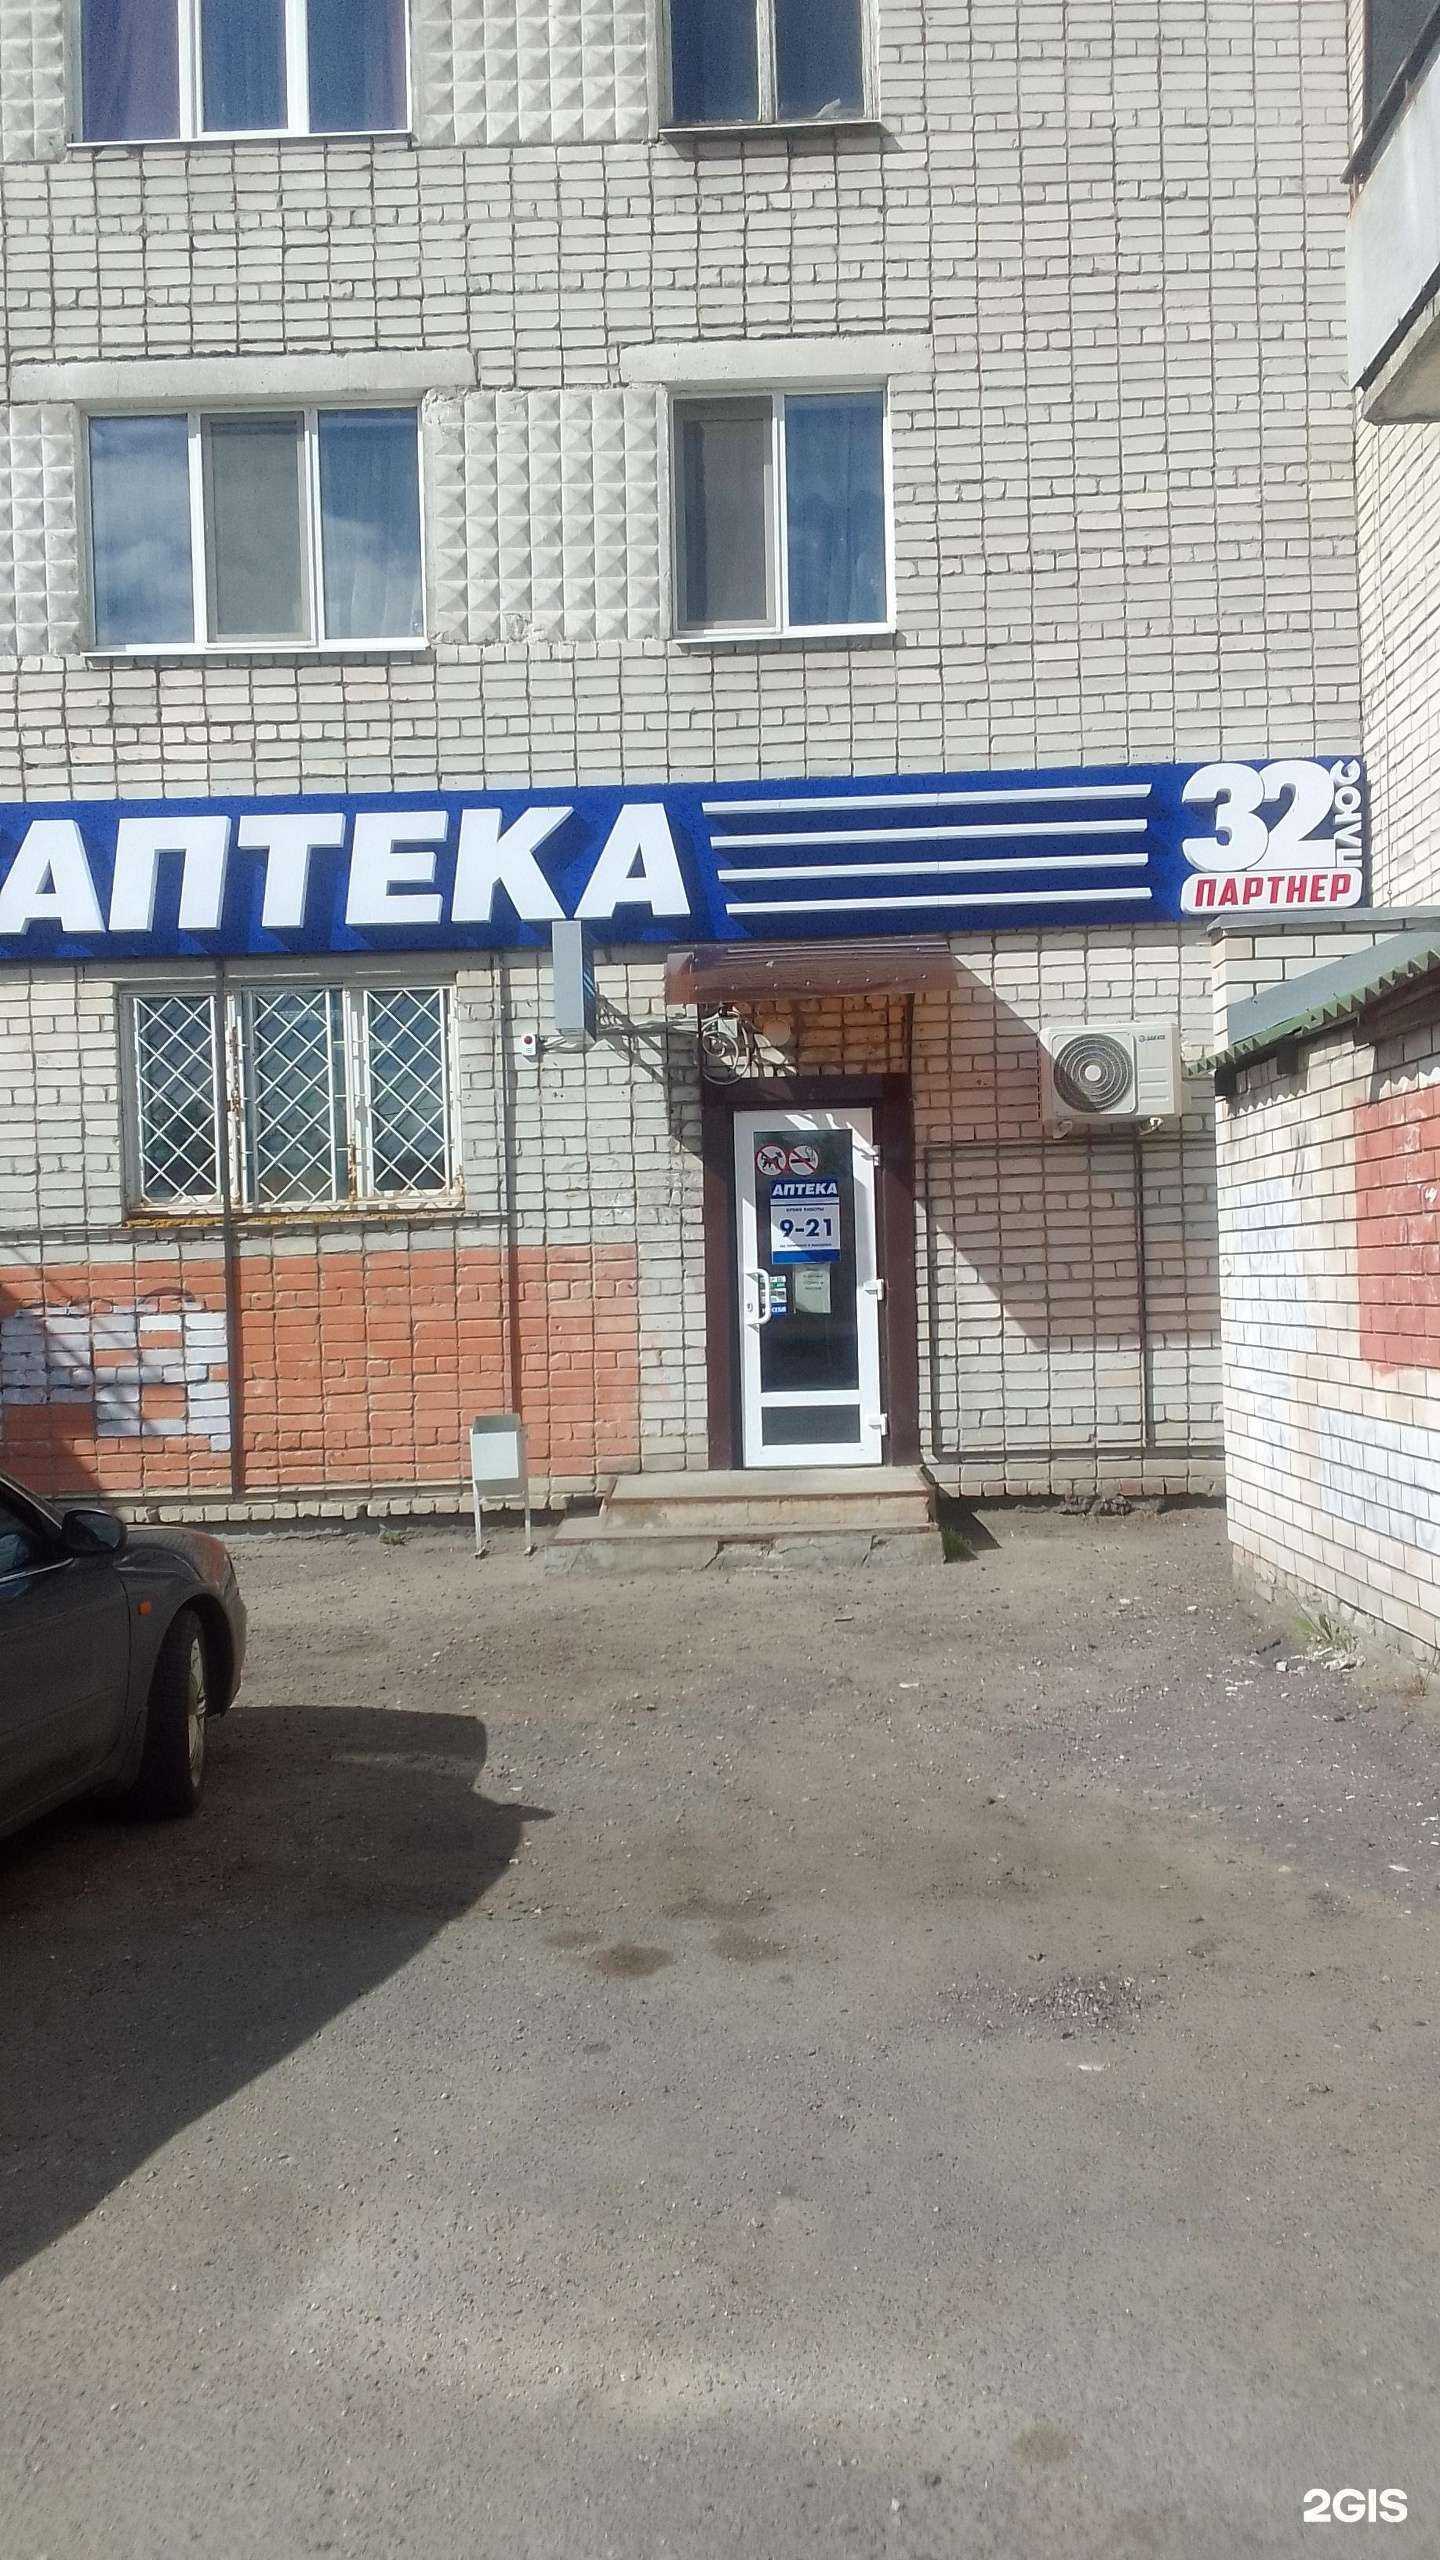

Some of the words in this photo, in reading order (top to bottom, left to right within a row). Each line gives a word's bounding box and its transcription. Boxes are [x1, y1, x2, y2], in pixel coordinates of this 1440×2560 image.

[1182, 760, 1335, 872] 32
[1332, 759, 1362, 867] ПЛЮС
[0, 803, 691, 934] АПТЕКА
[1195, 874, 1351, 907] ПАРТНЕР
[772, 1183, 838, 1196] АПТЕКА
[779, 1218, 832, 1237] 9-21
